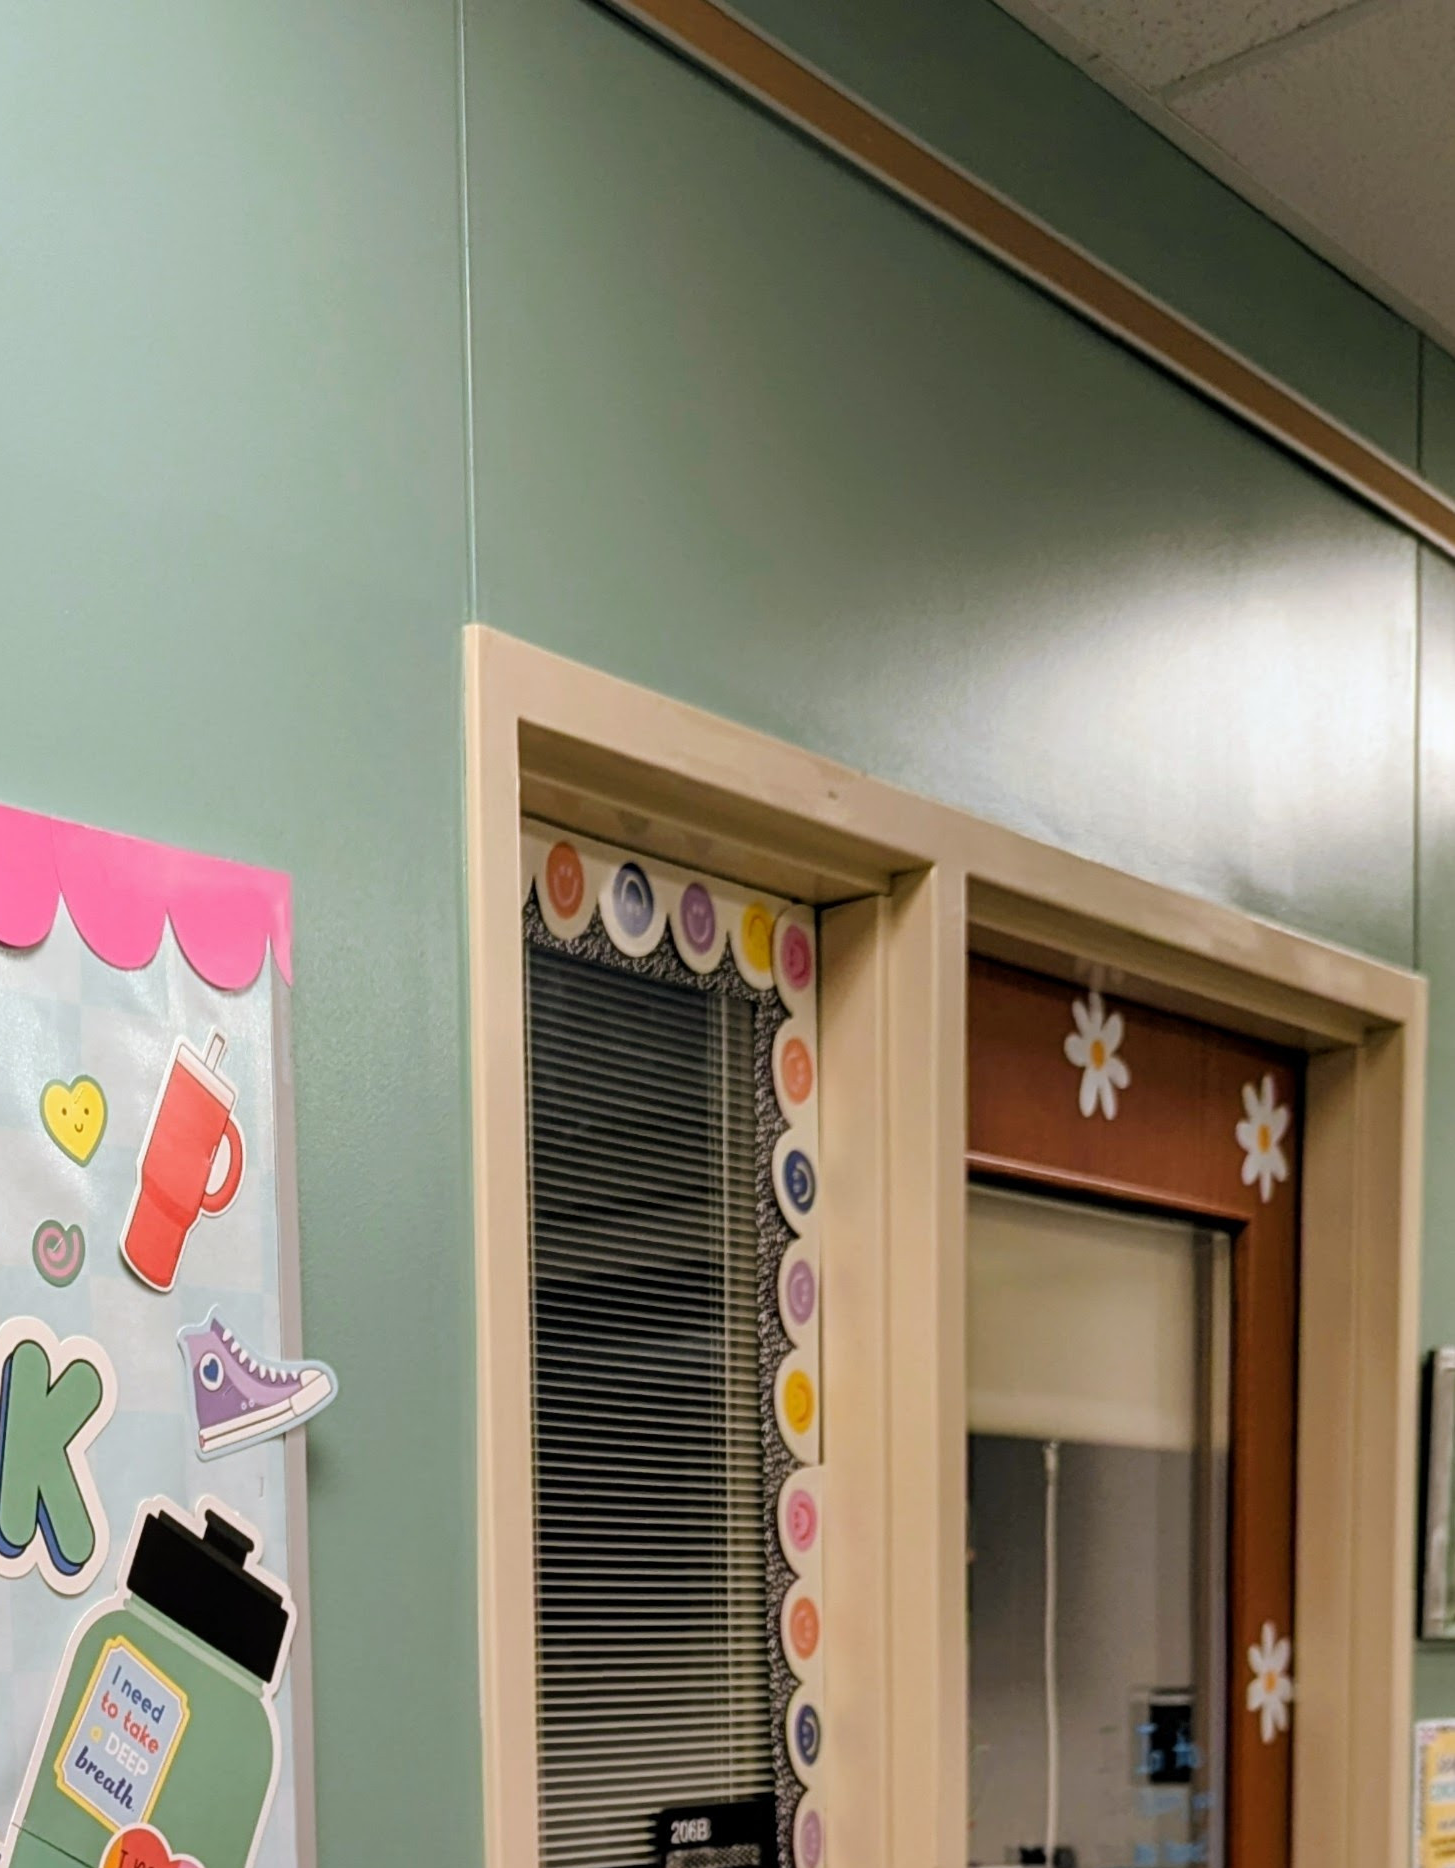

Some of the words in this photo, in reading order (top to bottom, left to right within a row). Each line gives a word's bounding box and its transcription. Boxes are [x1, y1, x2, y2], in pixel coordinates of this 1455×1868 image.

[112, 1665, 122, 1686] I
[121, 1679, 166, 1725] need
[101, 1690, 119, 1719] to
[123, 1710, 160, 1754] take
[105, 1732, 150, 1777] DEEP
[670, 1817, 711, 1845] 206B
